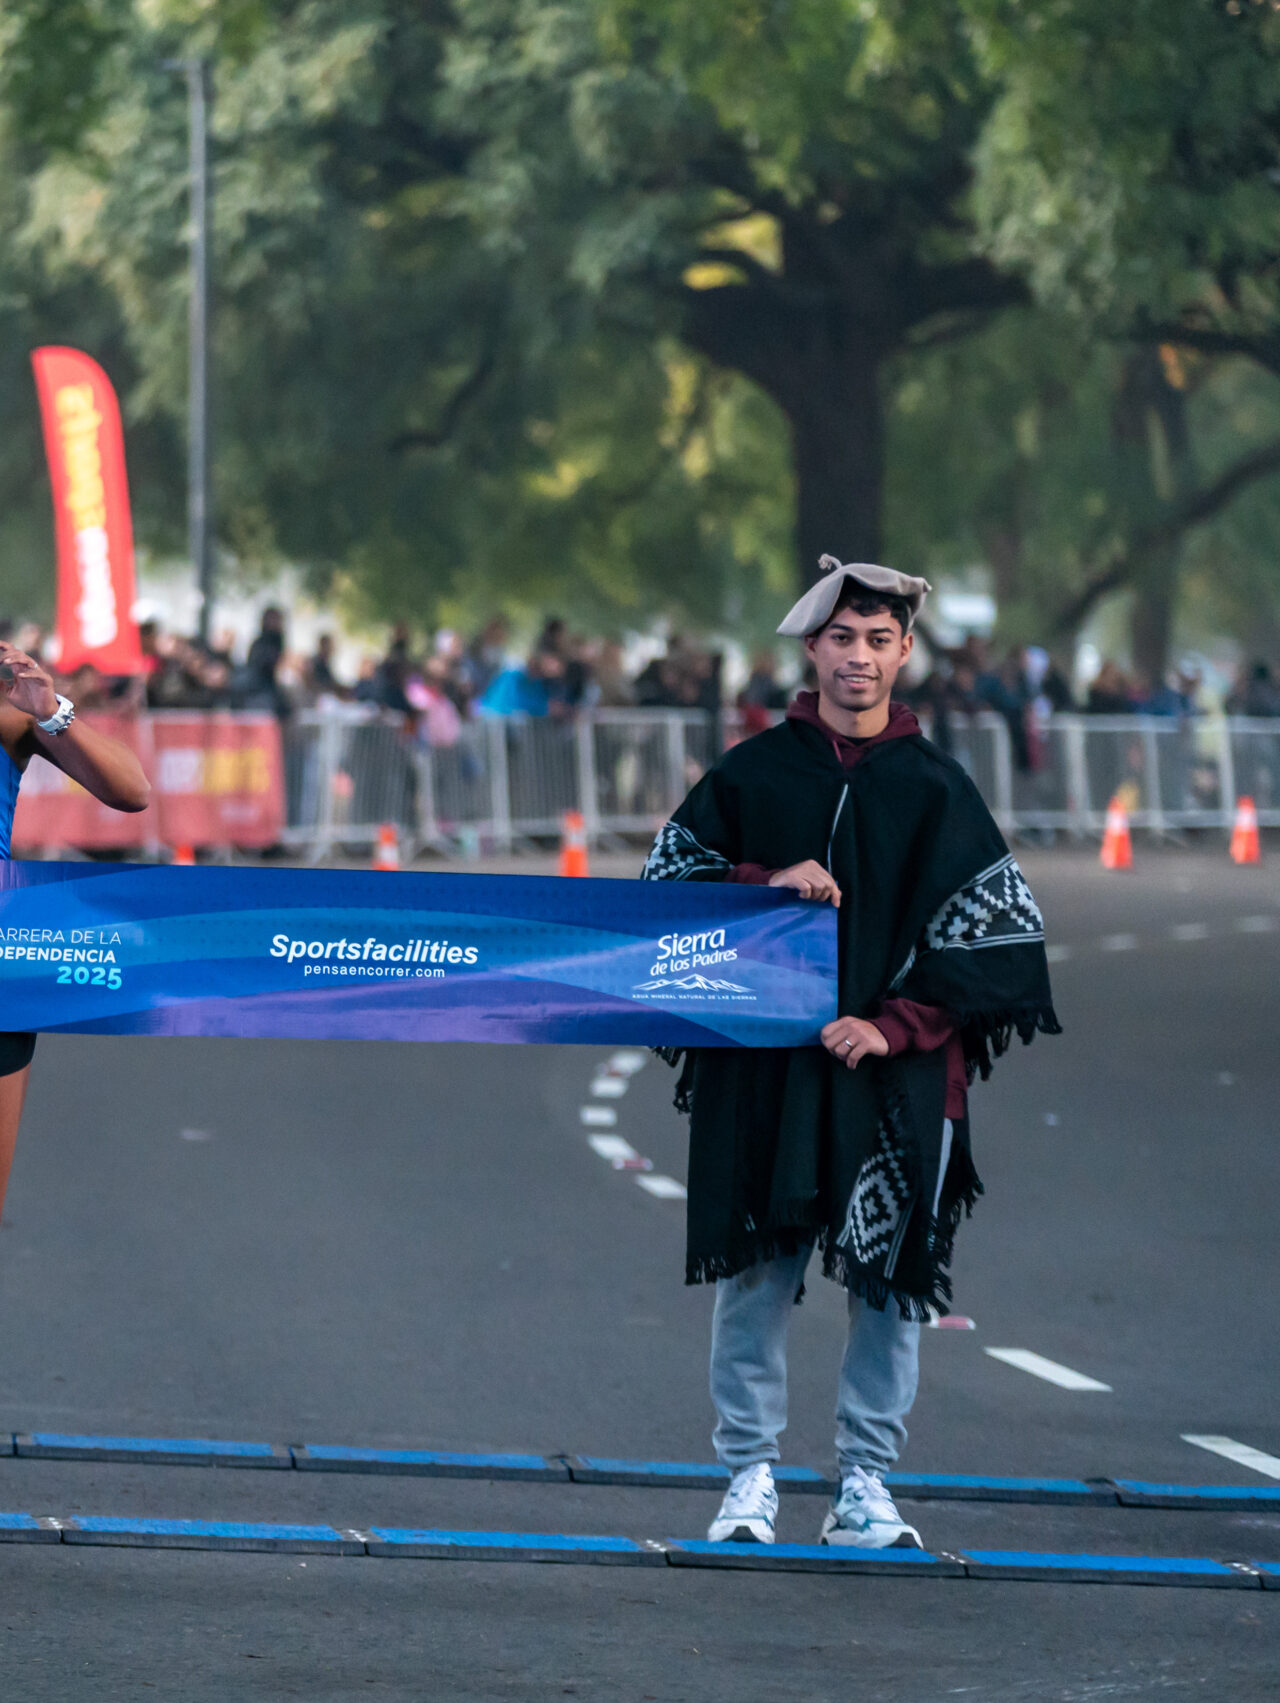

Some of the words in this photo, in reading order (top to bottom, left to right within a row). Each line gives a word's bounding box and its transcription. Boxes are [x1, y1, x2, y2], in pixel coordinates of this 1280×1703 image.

[71, 930, 95, 944] DE
[99, 931, 122, 945] LA
[270, 934, 479, 965] Sportsfacilities
[657, 928, 726, 960] Sierra
[304, 964, 446, 978] pensaencorrer.com
[650, 961, 668, 976] de
[670, 958, 690, 973] los
[692, 948, 738, 968] Padres
[56, 965, 123, 990] 2025
